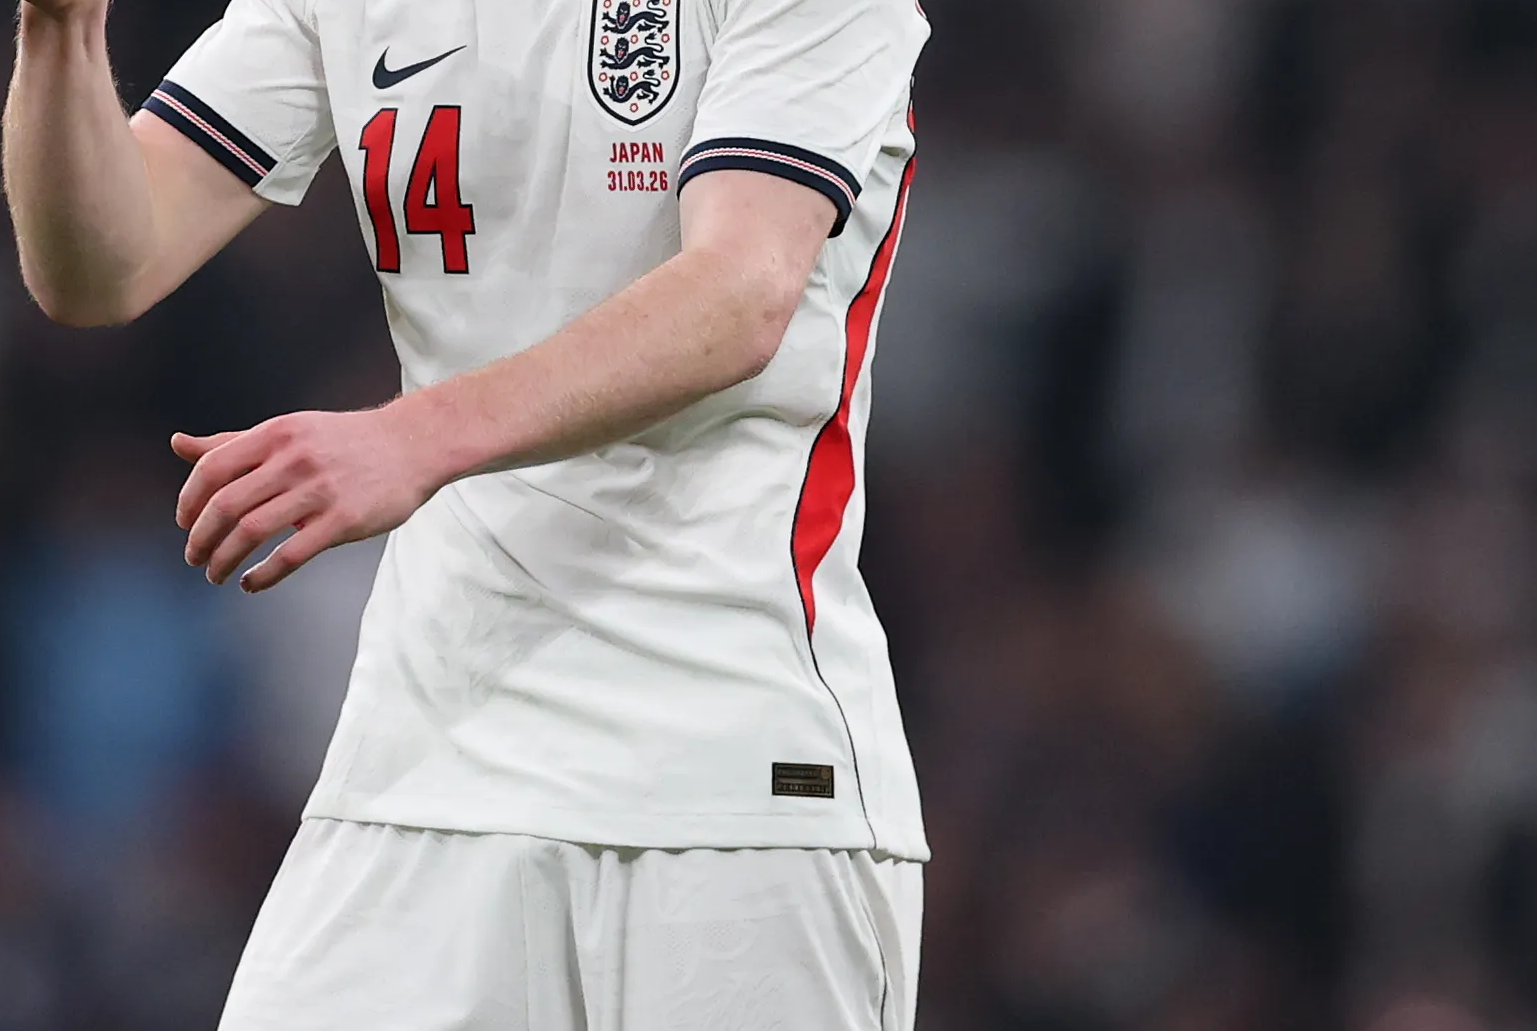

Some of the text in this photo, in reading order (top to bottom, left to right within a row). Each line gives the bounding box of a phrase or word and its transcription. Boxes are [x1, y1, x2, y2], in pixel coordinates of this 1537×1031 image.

[609, 142, 664, 163] JAPAN
[358, 105, 476, 274] 14
[607, 170, 669, 192] 31.03.26
